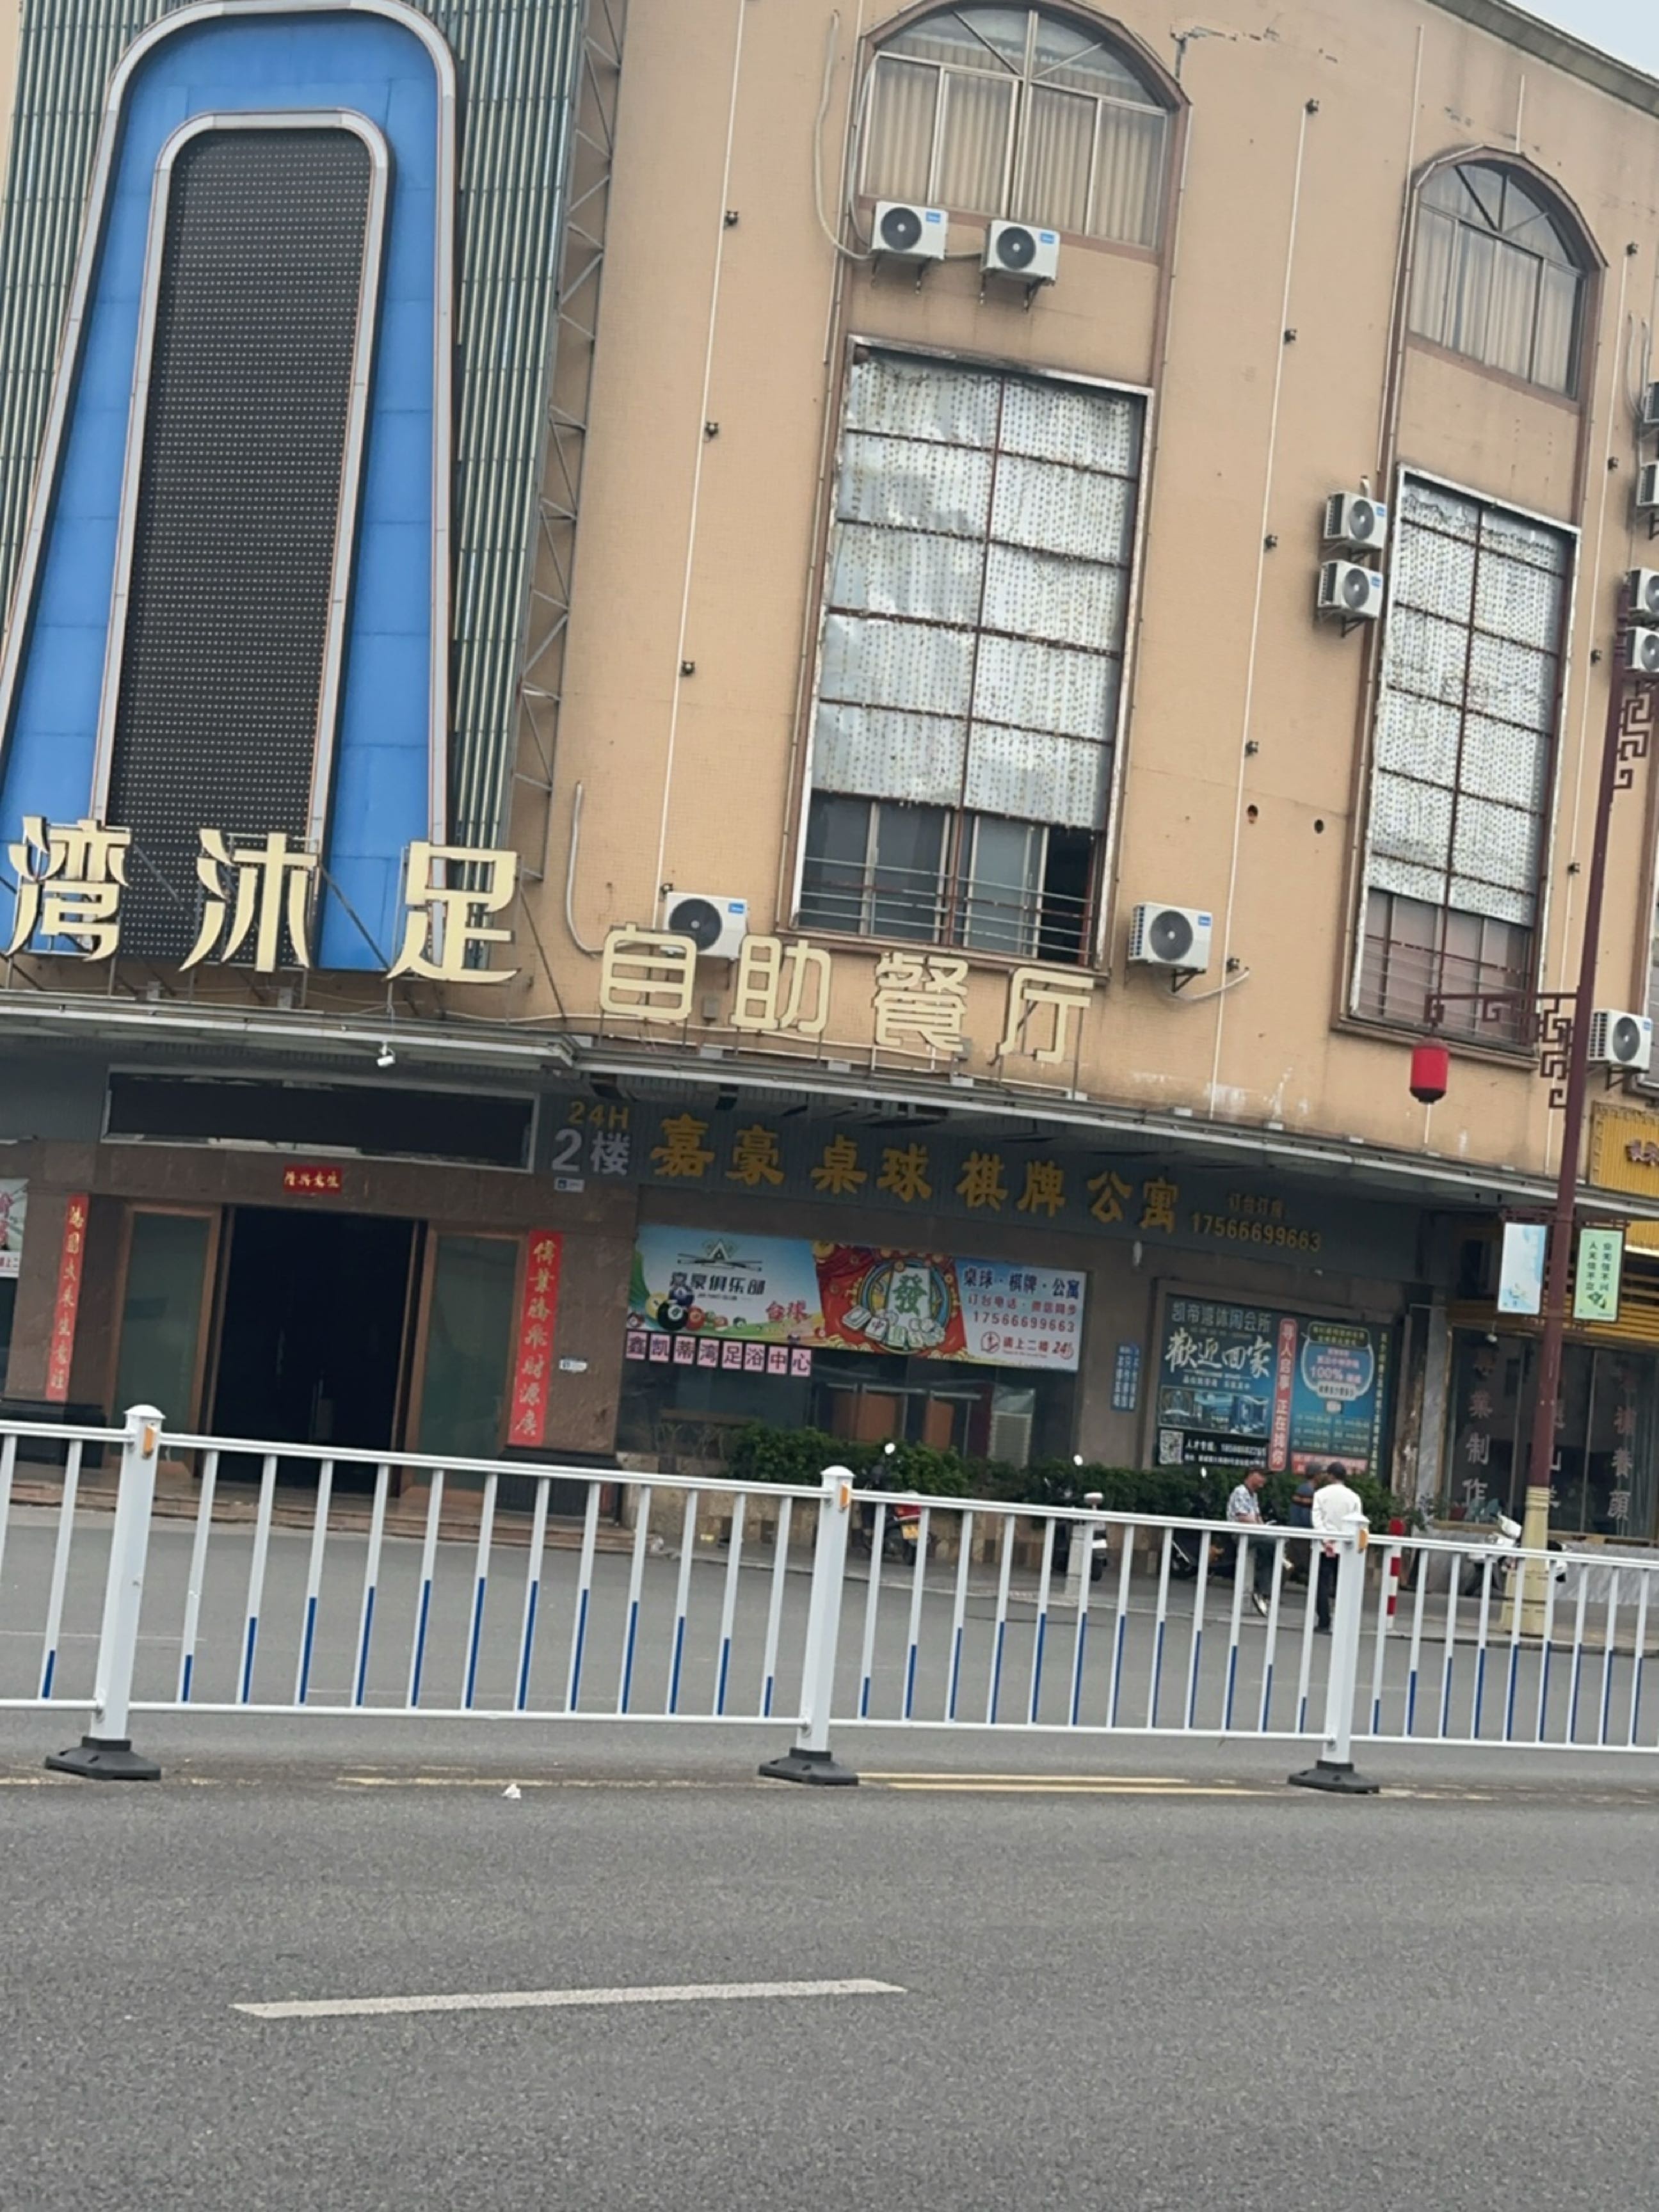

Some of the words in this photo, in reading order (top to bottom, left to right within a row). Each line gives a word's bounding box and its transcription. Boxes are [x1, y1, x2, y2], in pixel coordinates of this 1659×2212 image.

[600, 924, 1094, 1064] 自助餐厅
[568, 1101, 629, 1130] 24H
[552, 1128, 630, 1176] 2楼
[1191, 1212, 1322, 1253] 17566699663
[974, 1311, 1075, 1333] 17566699663
